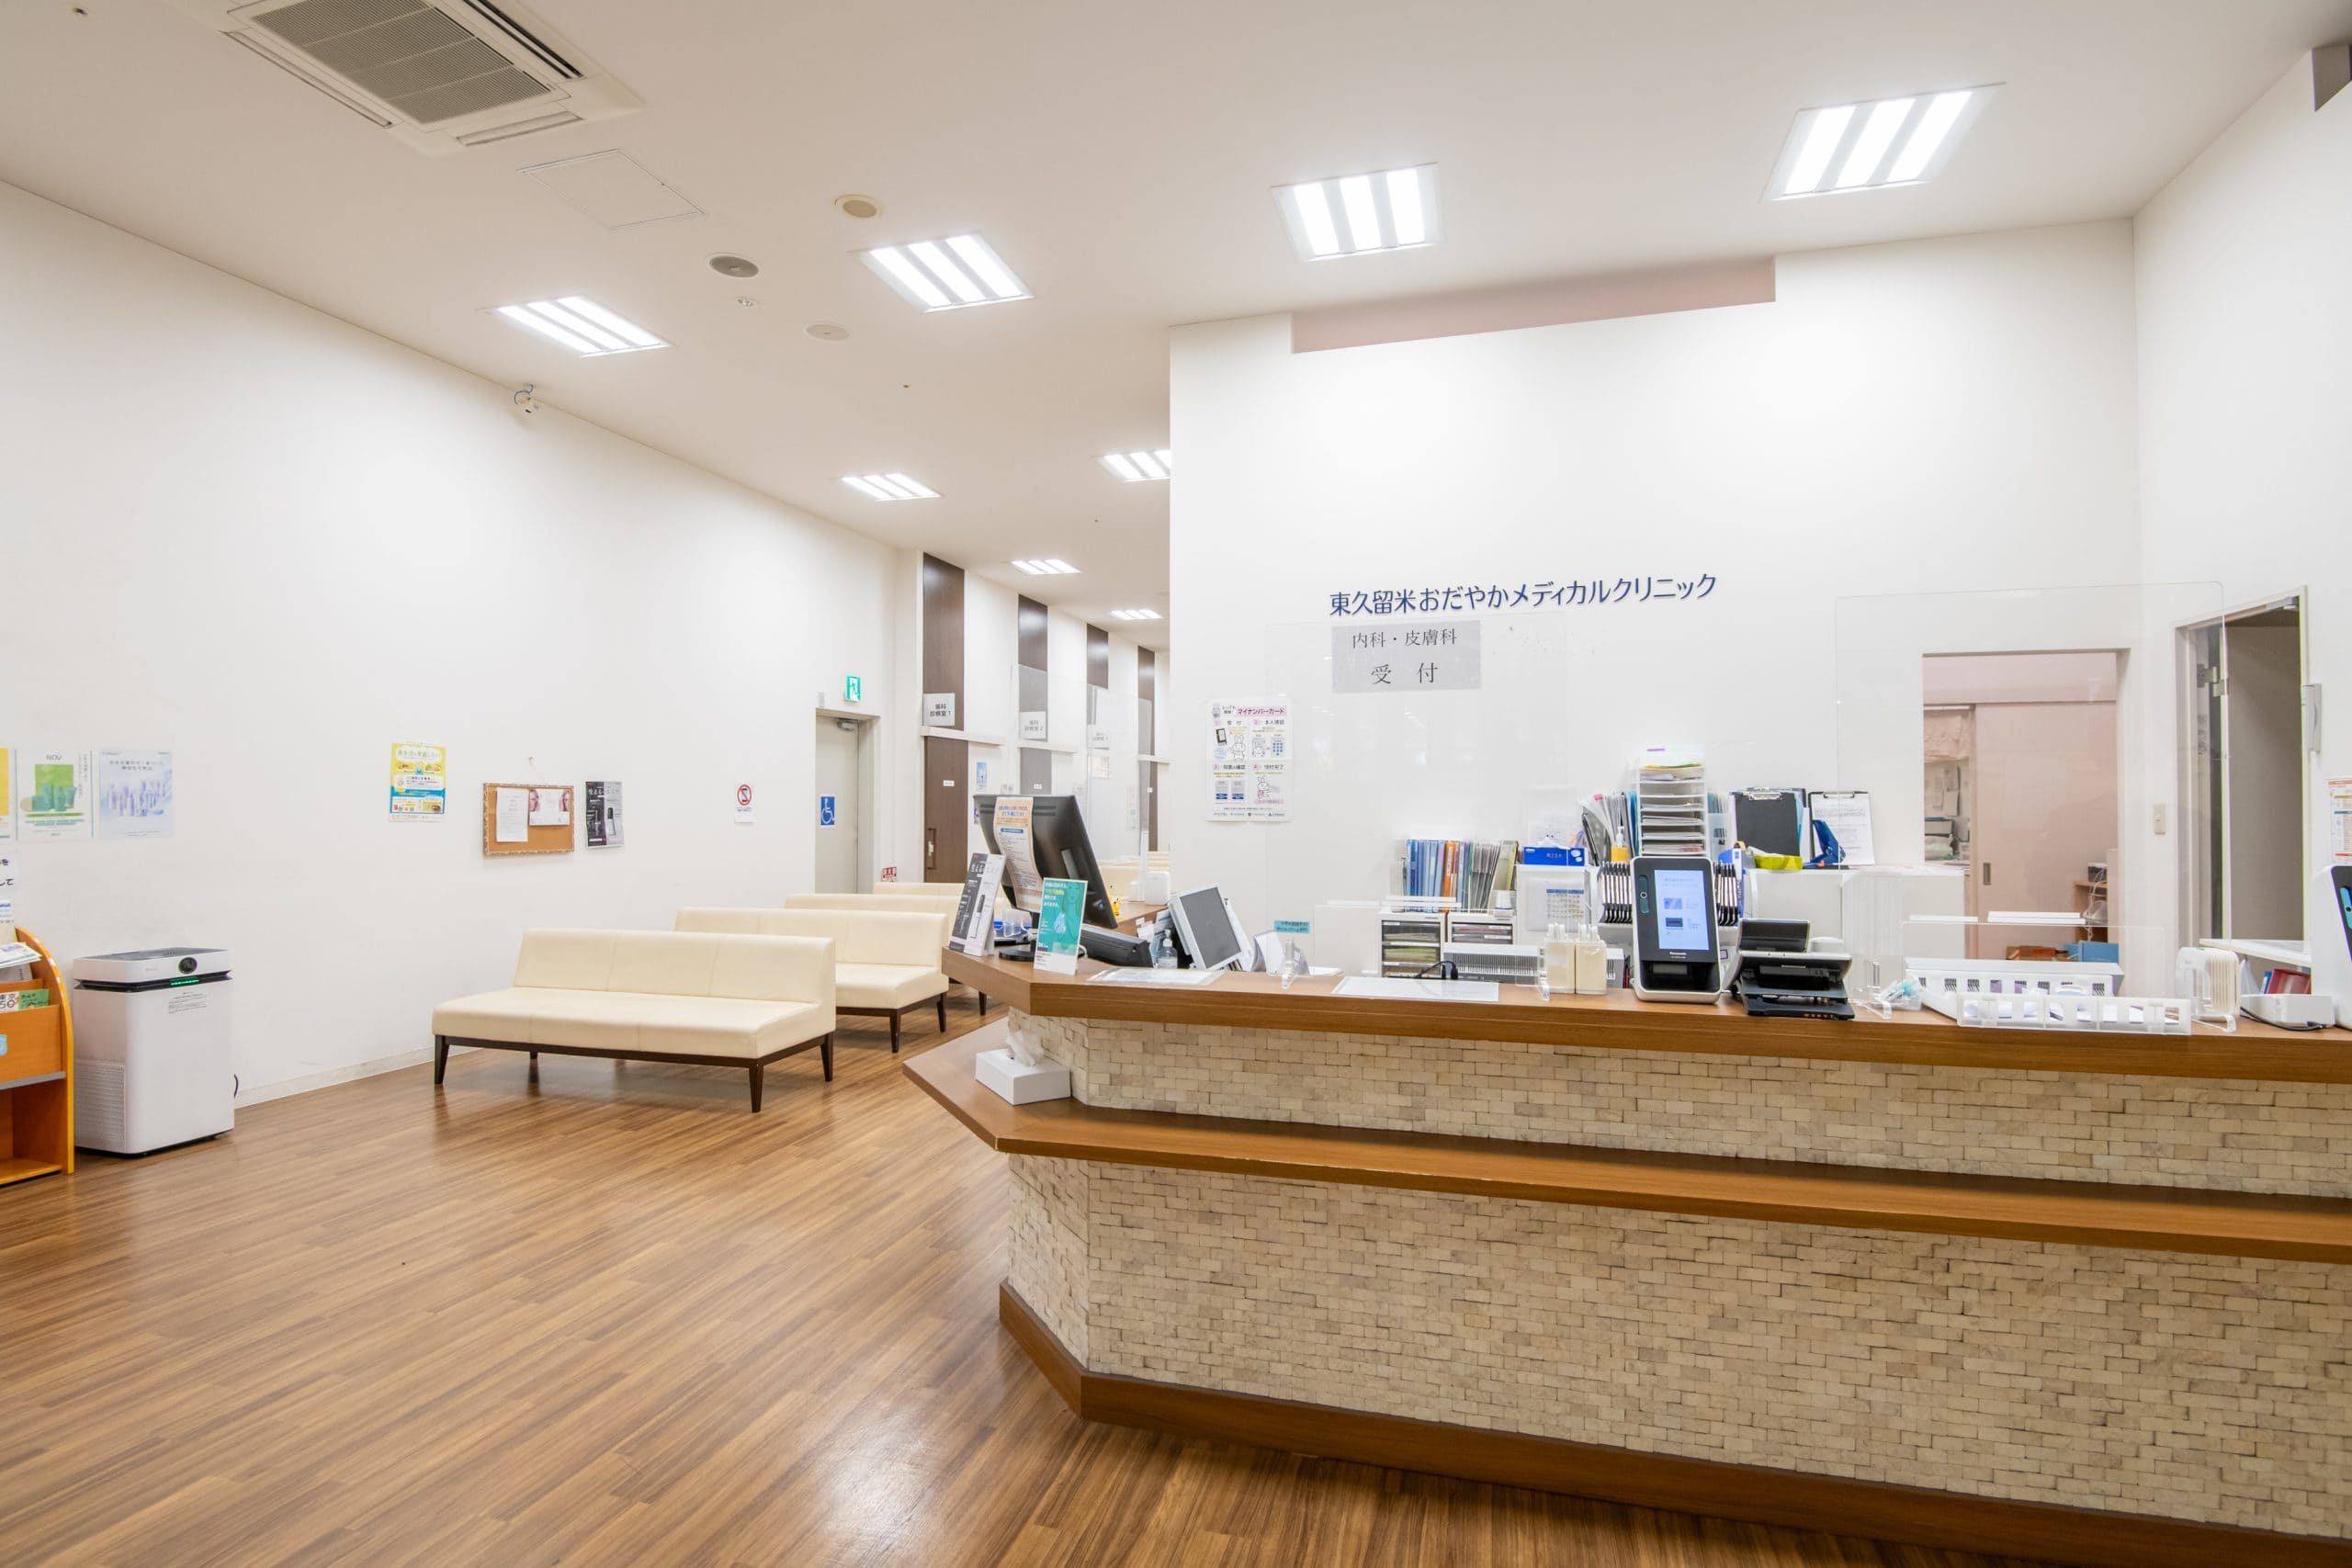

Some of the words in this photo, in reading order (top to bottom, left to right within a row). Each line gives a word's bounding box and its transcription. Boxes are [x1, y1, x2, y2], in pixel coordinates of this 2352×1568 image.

[1329, 573, 1716, 616] 東久留米おだやかメディカルクリニック
[1352, 629, 1457, 649] 内科・皮膚科
